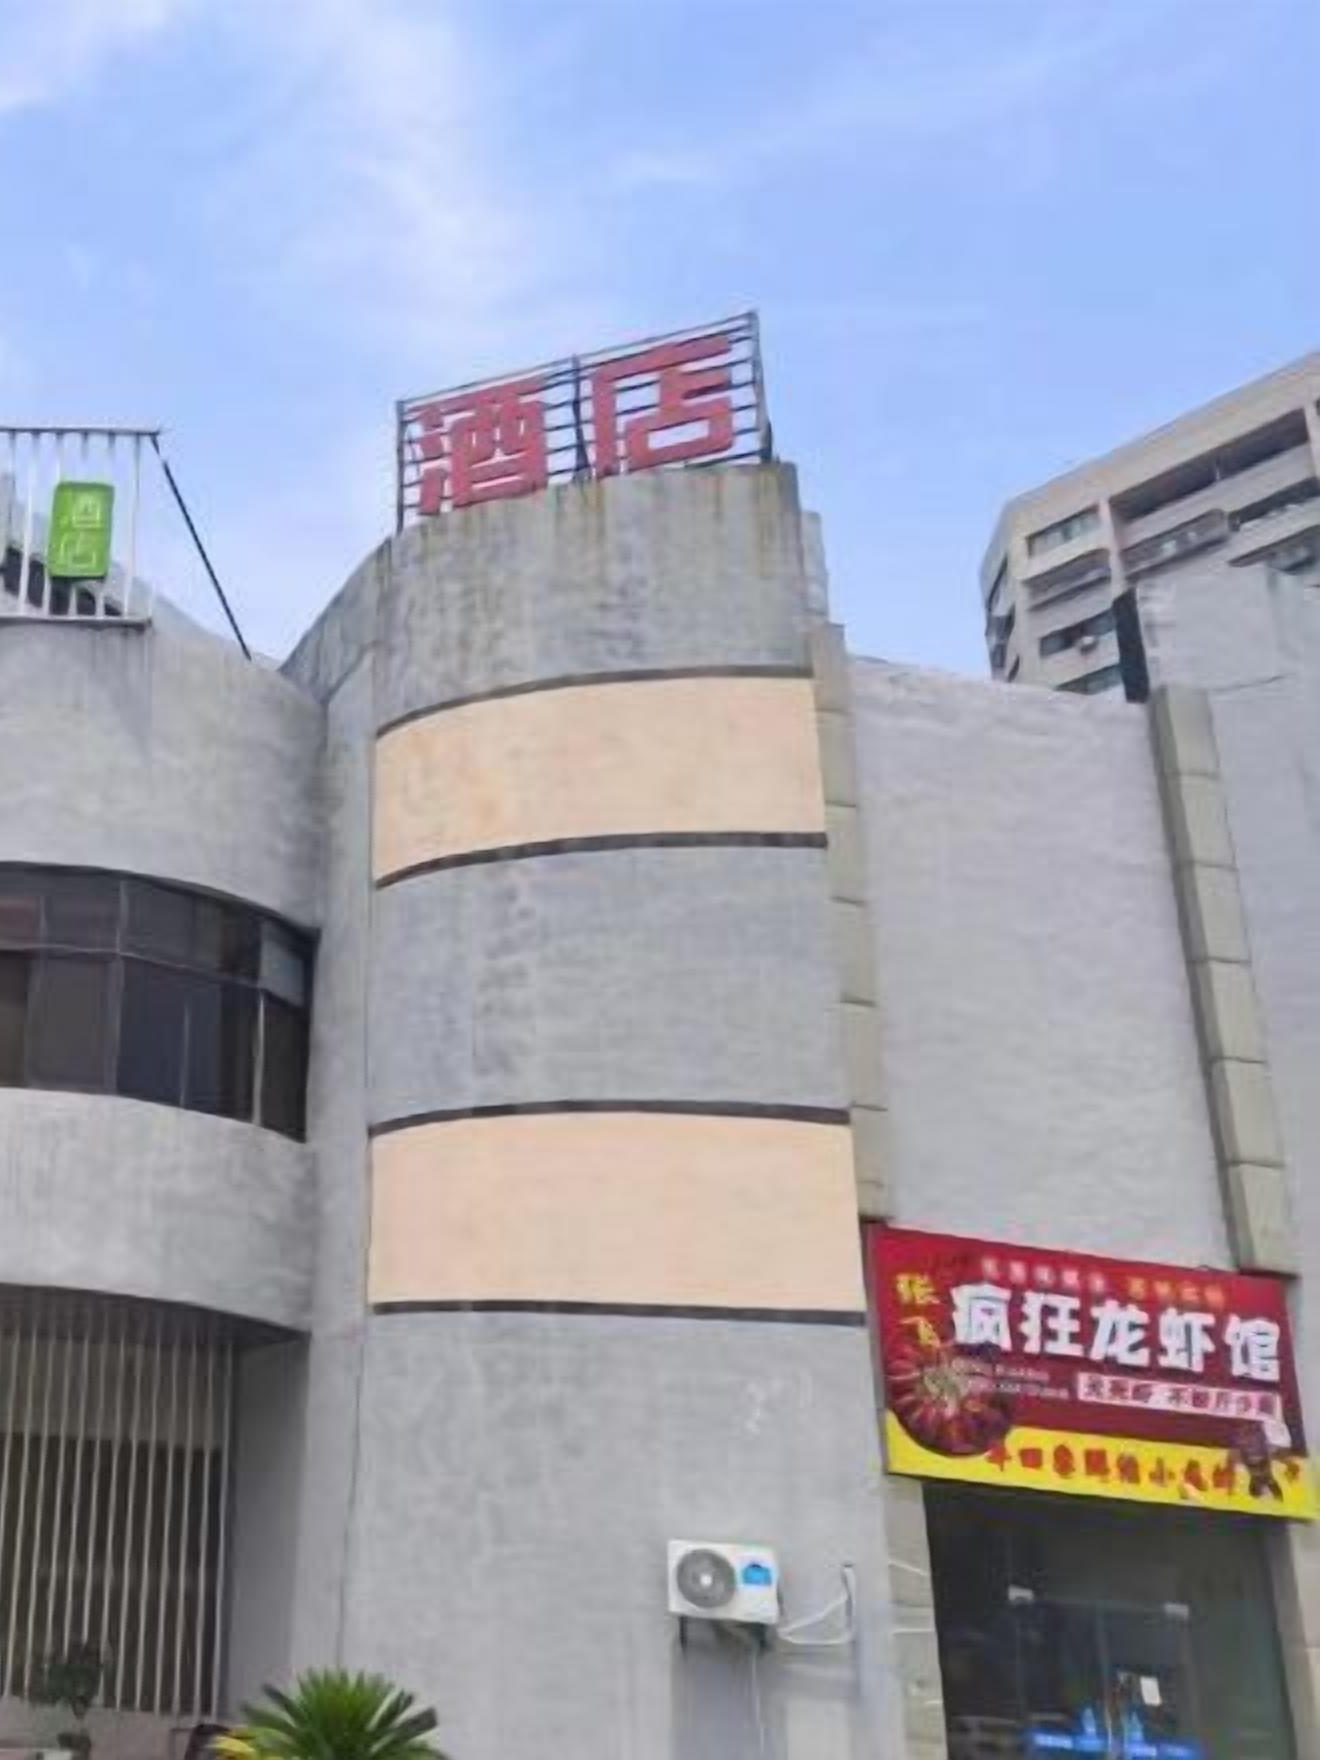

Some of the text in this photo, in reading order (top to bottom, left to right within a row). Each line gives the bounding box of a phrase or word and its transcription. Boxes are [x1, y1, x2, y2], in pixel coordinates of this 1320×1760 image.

[412, 333, 733, 516] 酒店
[950, 1281, 1280, 1383] 疯狂龙虾馆
